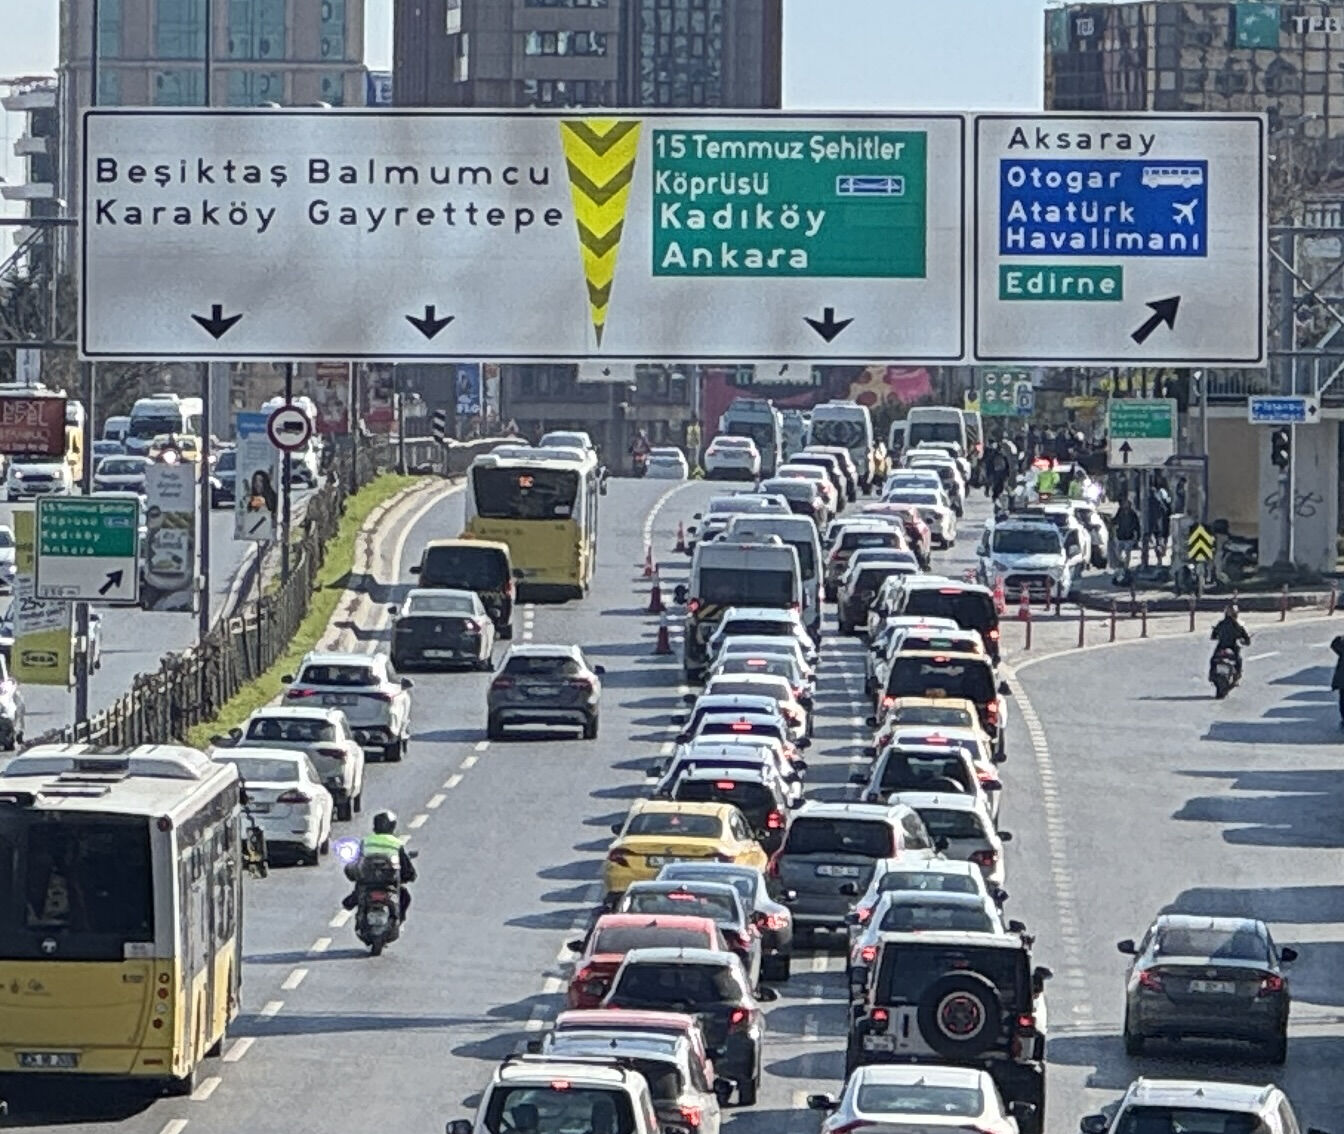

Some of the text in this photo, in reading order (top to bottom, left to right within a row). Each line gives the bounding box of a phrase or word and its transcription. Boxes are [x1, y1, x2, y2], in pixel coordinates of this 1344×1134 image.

[656, 135, 904, 165] 15 Temmuz Şehitler
[1008, 126, 1156, 155] Aksaray
[96, 158, 549, 187] Beşiktaş Balmumcu
[656, 171, 770, 196] Köprüsü
[1007, 165, 1121, 190] Otogar
[96, 199, 563, 233] Karaköy Gayrettepe
[661, 202, 826, 234] Kadıköy
[1007, 200, 1134, 223] Atatürk
[1007, 227, 1201, 251] Havalimanı
[661, 242, 809, 270] Ankara
[1007, 272, 1117, 295] Edirne
